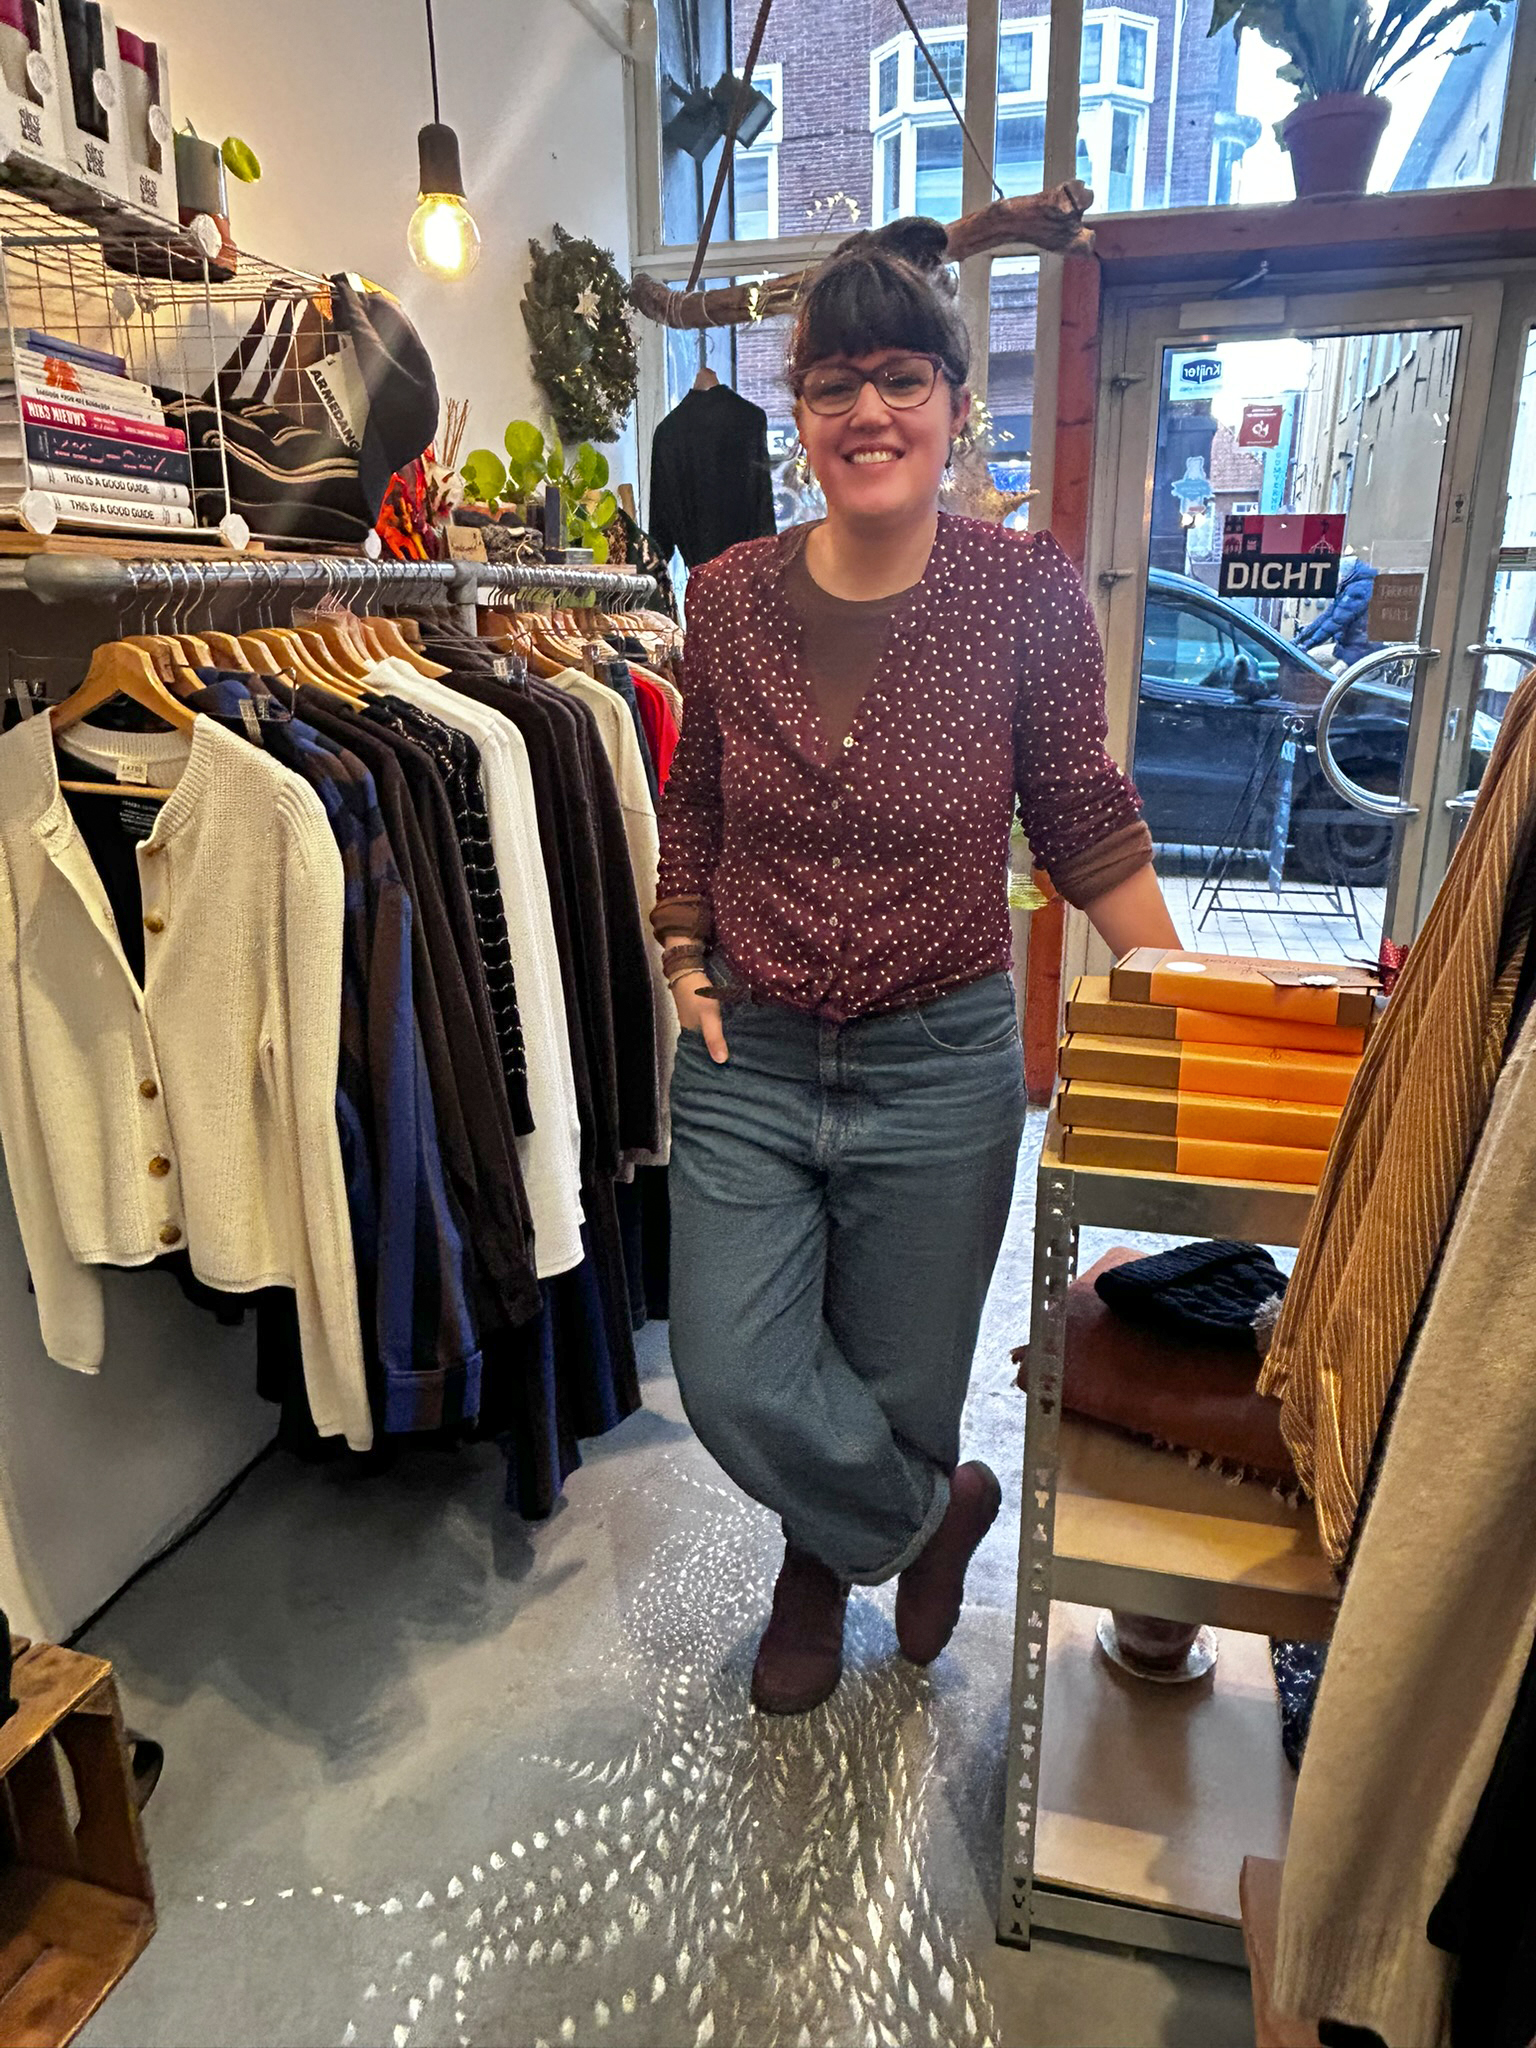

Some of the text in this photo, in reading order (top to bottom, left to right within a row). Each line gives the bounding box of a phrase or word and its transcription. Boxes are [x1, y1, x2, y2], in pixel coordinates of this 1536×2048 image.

[51, 406, 87, 428] NIEUWS
[64, 472, 84, 484] THIS
[85, 476, 94, 486] IS
[102, 478, 126, 491] GOOD
[70, 499, 90, 511] THIS
[90, 502, 99, 512] IS
[107, 504, 131, 517] GOOD
[131, 507, 155, 520] GUIDE
[1228, 563, 1331, 590] DICHT
